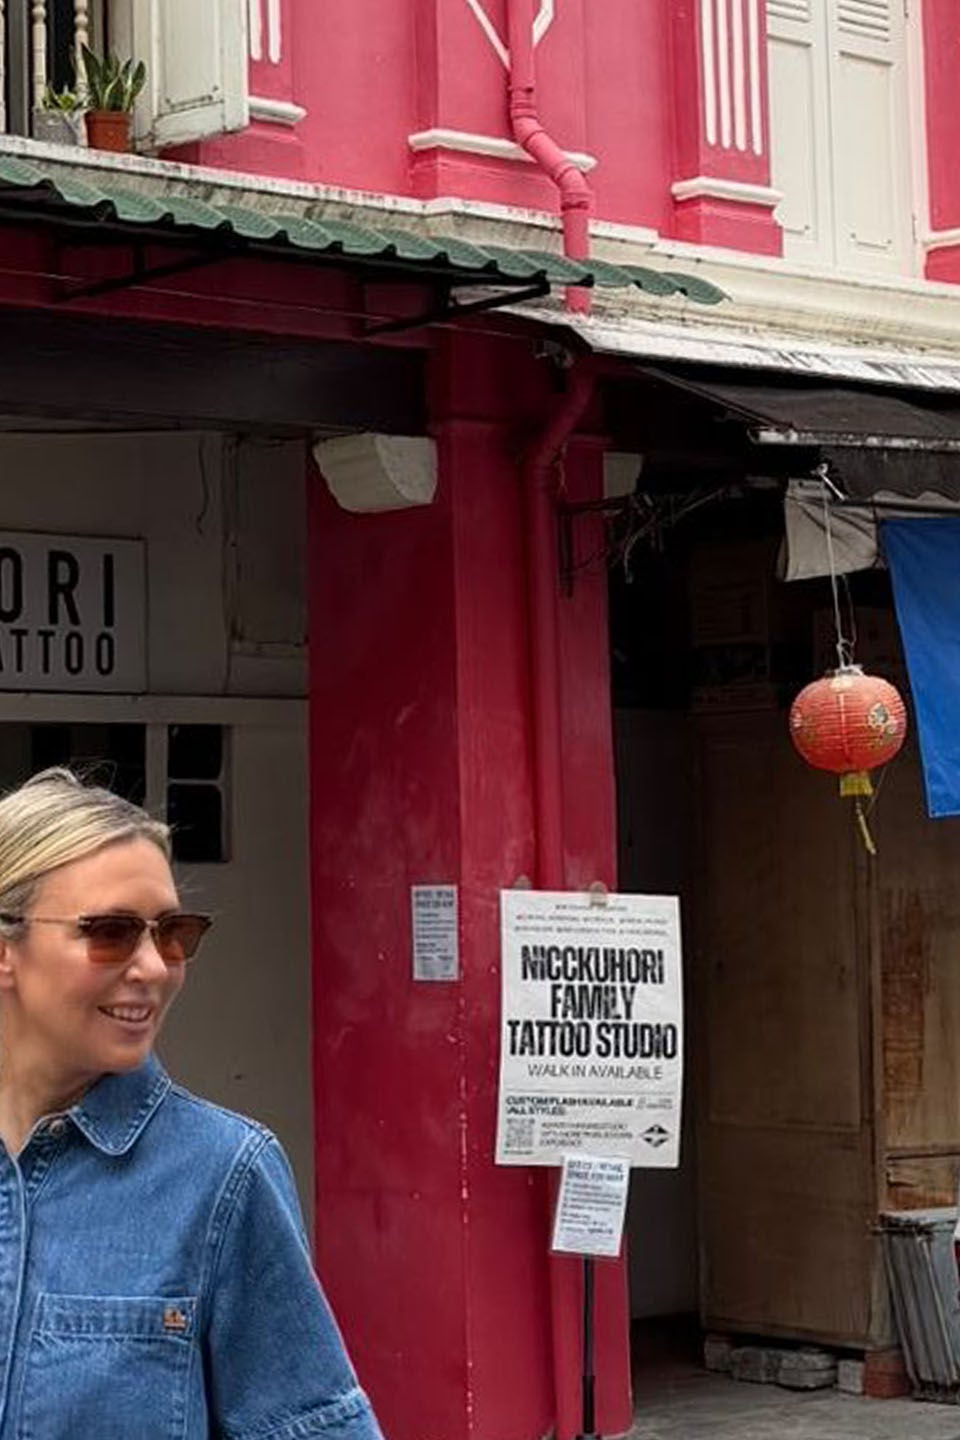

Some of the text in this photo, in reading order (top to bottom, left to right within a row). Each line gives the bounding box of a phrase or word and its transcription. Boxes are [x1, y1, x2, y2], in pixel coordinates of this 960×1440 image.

[520, 945, 665, 984] NICCKUHORI
[550, 983, 636, 1020] FAMILY
[507, 1019, 678, 1059] TATTOO STUDIO
[528, 1064, 663, 1080] WALK IN AVAILABLE
